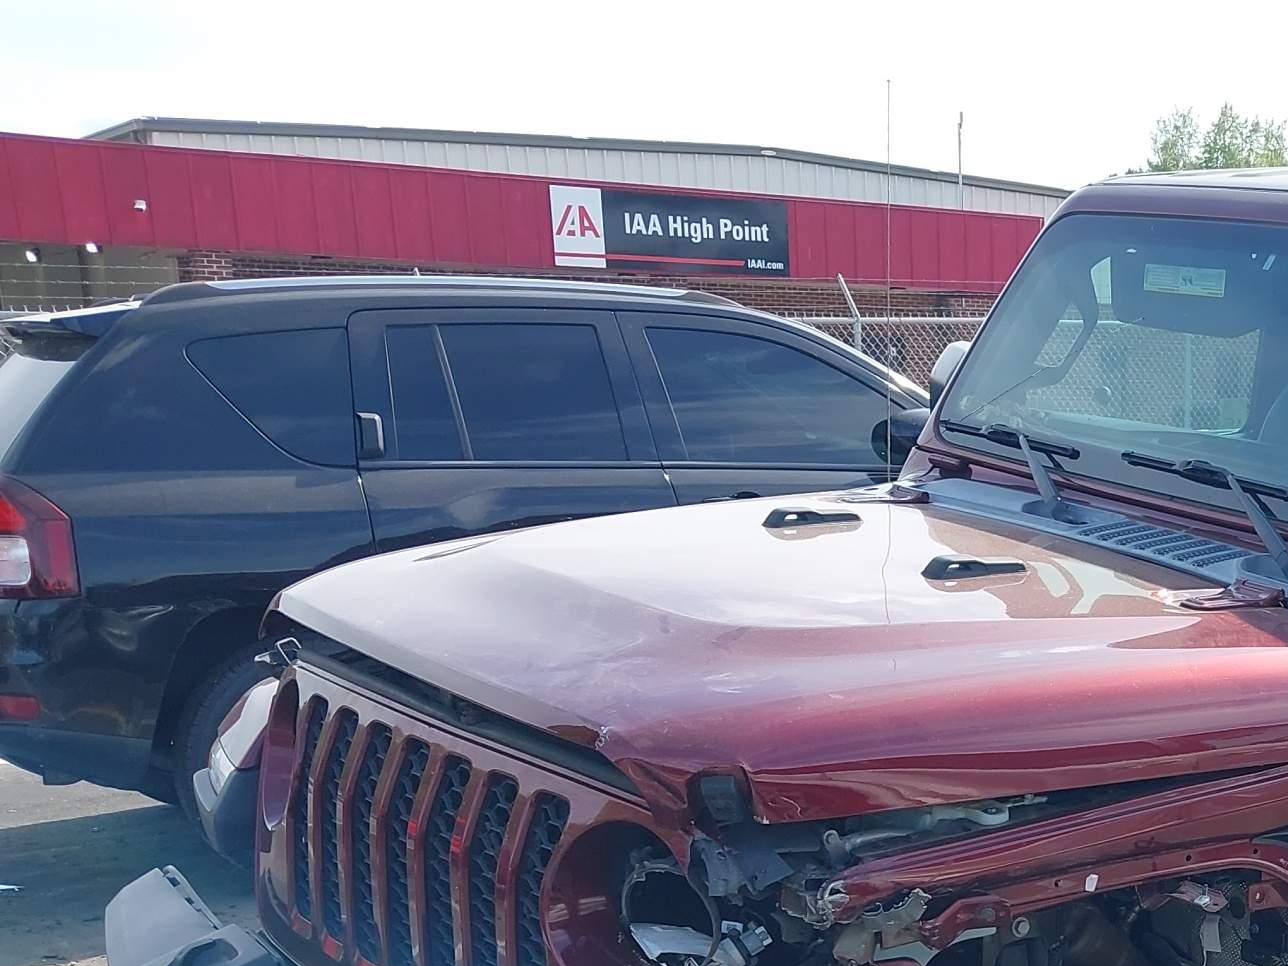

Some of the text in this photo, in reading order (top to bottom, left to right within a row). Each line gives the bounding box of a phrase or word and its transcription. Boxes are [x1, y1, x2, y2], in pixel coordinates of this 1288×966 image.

[624, 212, 769, 243] IAA High Point
